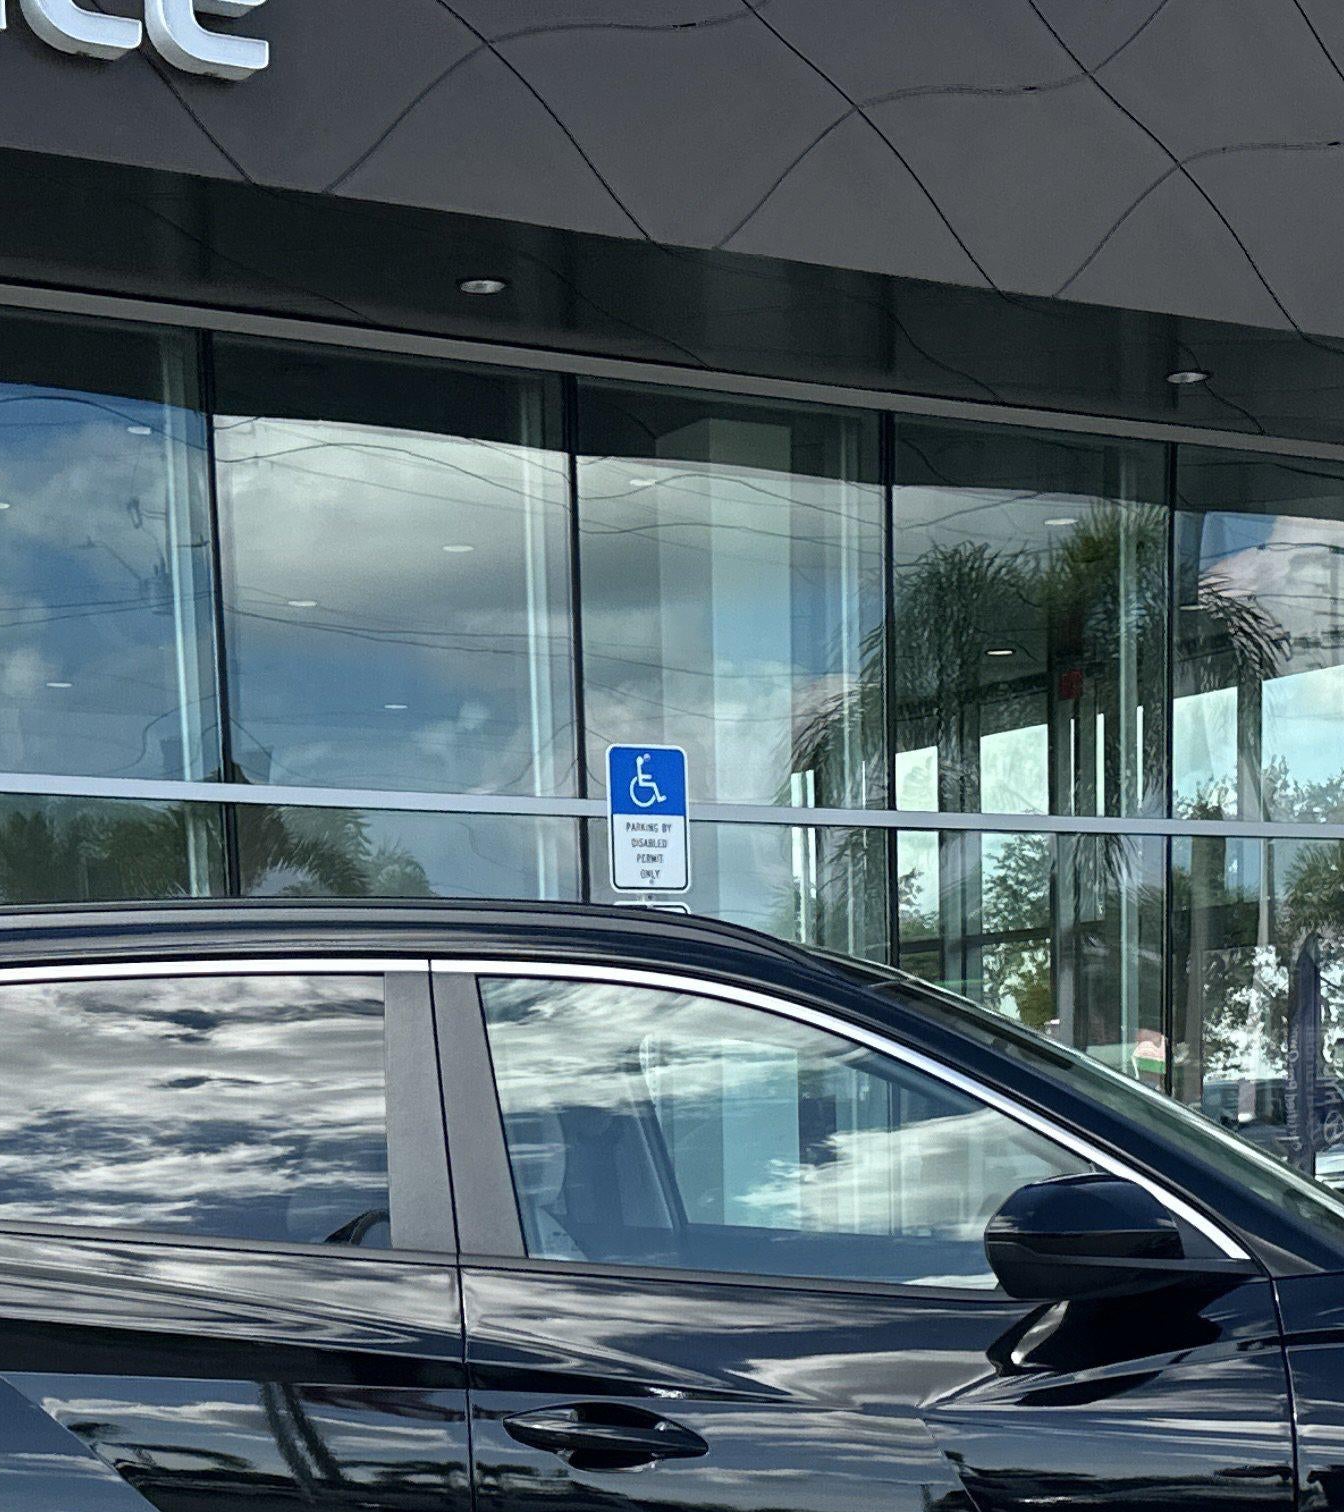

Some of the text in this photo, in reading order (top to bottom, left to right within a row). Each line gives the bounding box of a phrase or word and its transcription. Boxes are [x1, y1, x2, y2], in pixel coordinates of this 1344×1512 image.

[625, 822, 672, 833] PARKING BY
[631, 838, 668, 848] DISABLED
[636, 854, 664, 864] PERMIT
[640, 869, 660, 880] ONLY
